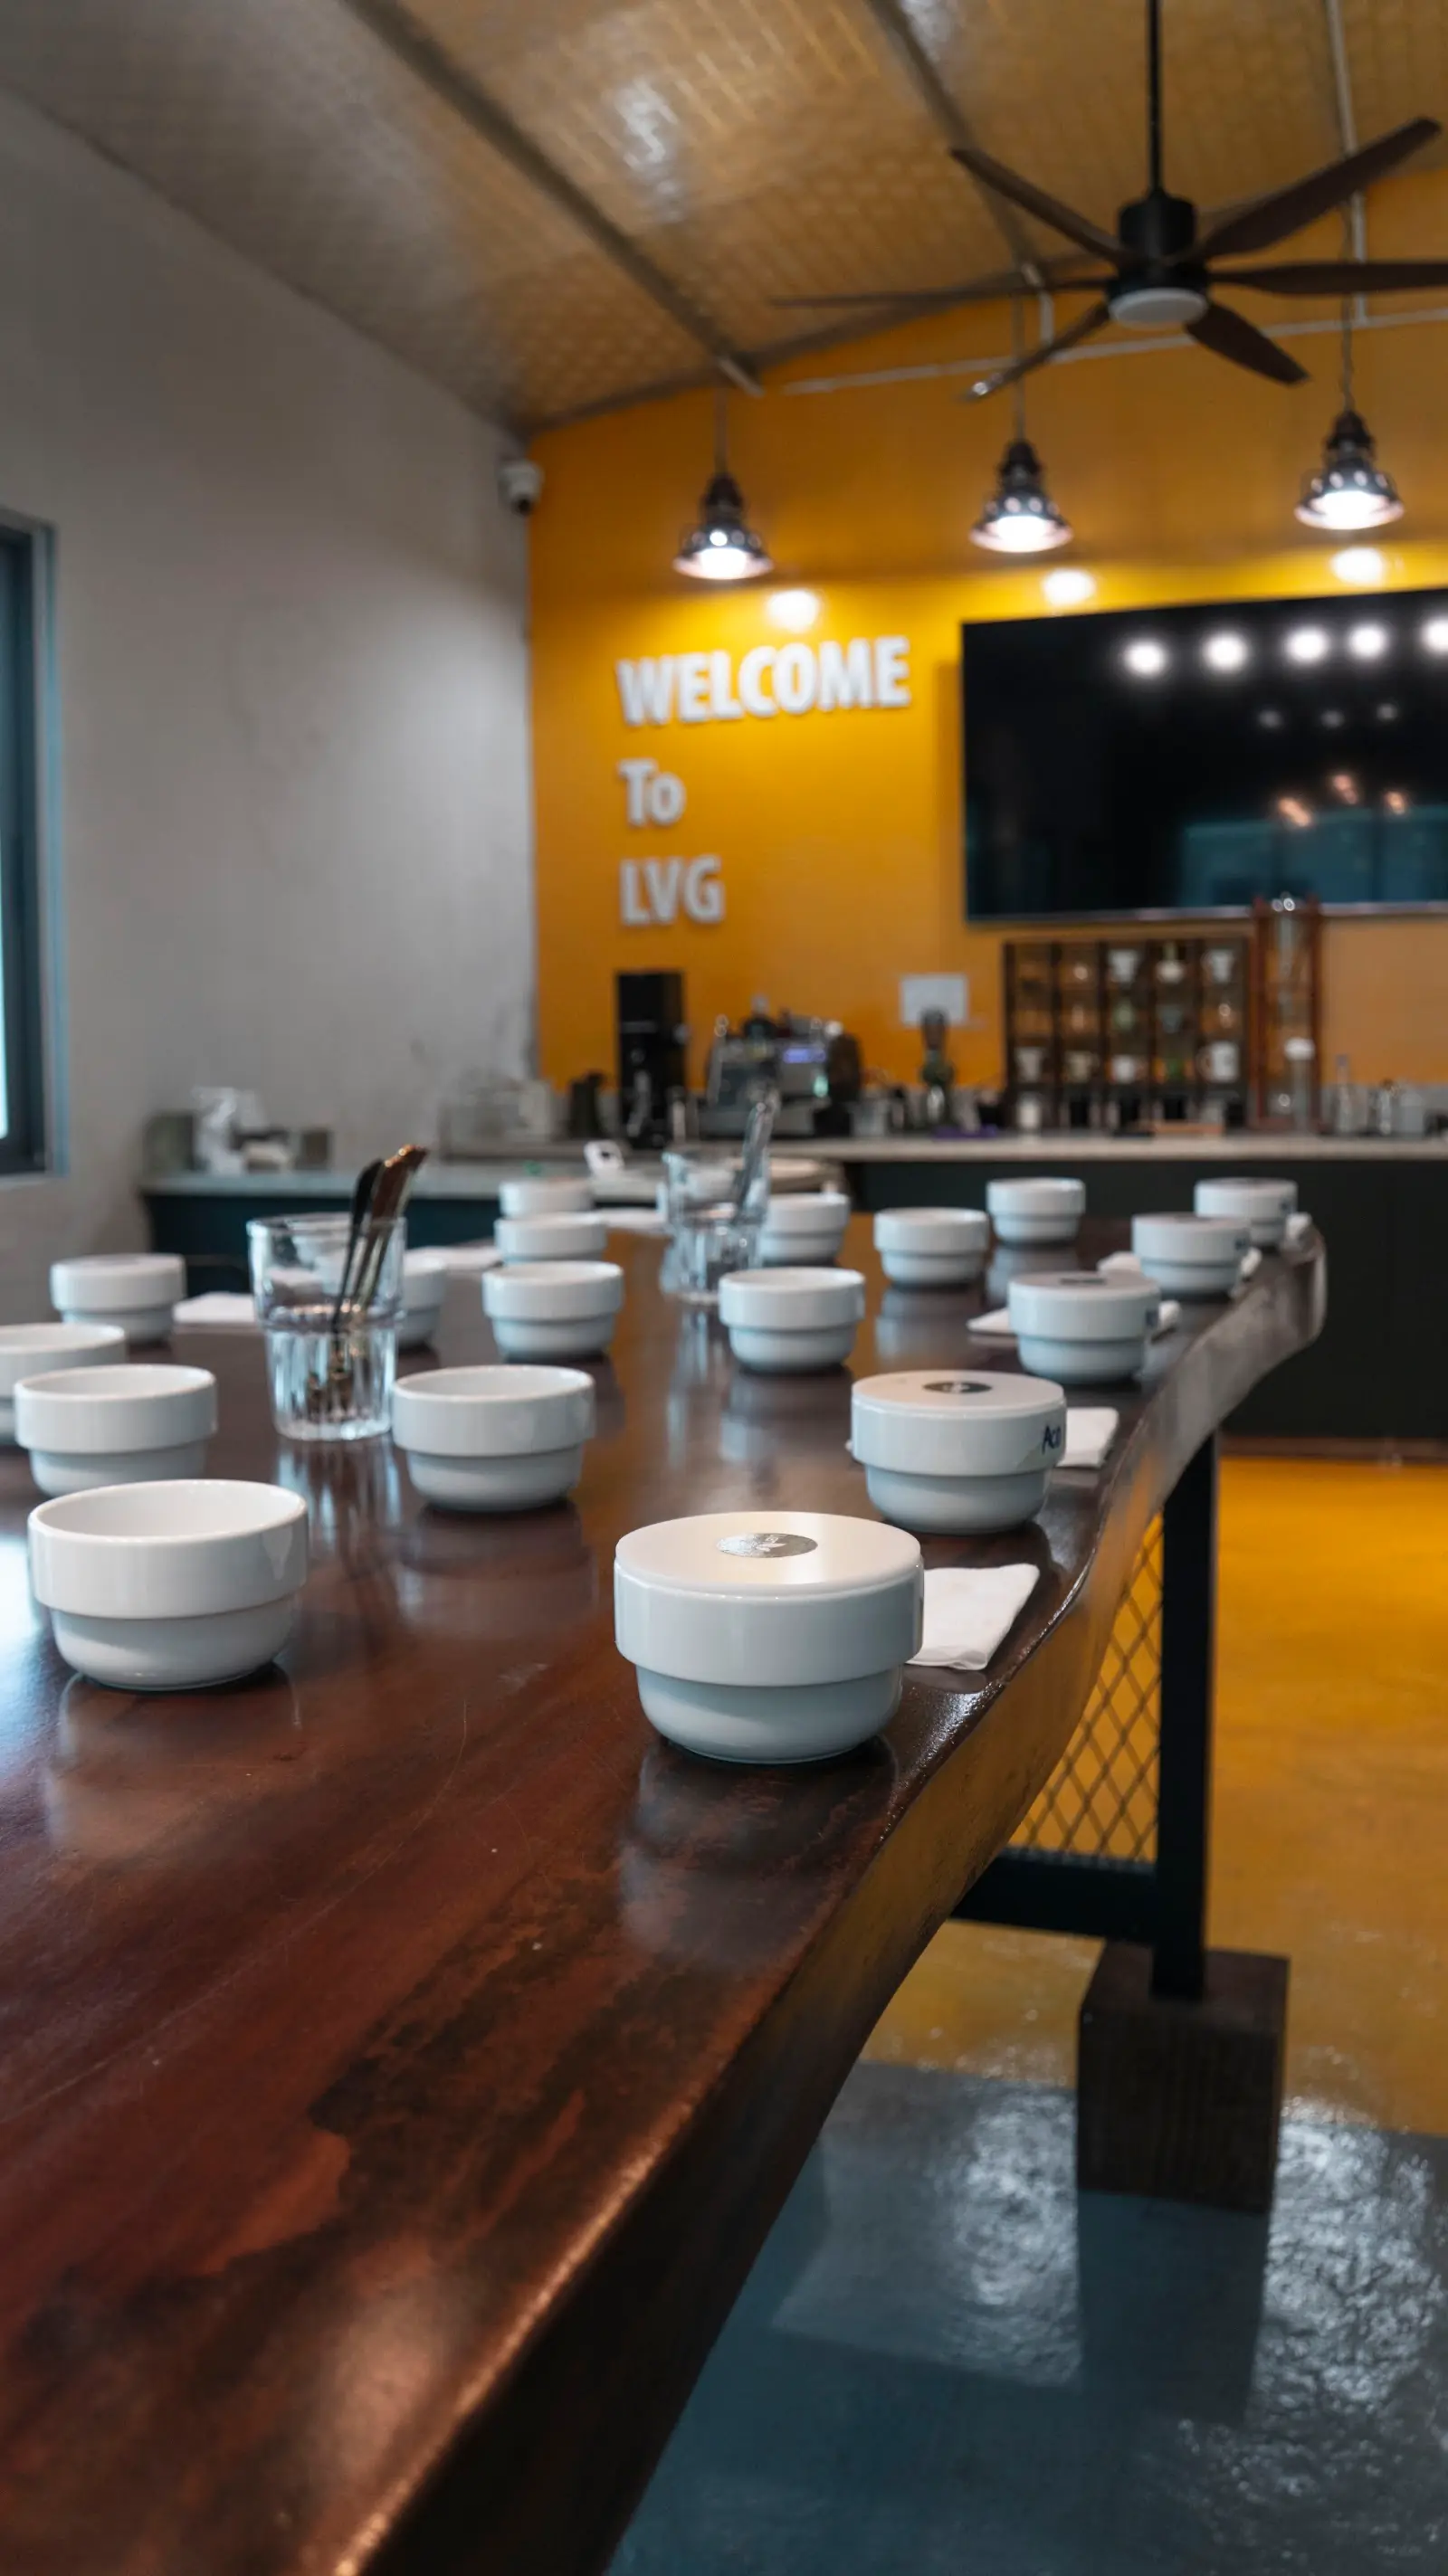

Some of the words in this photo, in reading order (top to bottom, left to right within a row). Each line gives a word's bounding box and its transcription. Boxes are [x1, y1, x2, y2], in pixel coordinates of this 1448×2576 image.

[617, 636, 910, 725] WELCOME
[618, 758, 685, 826] To
[621, 854, 726, 925] LVG
